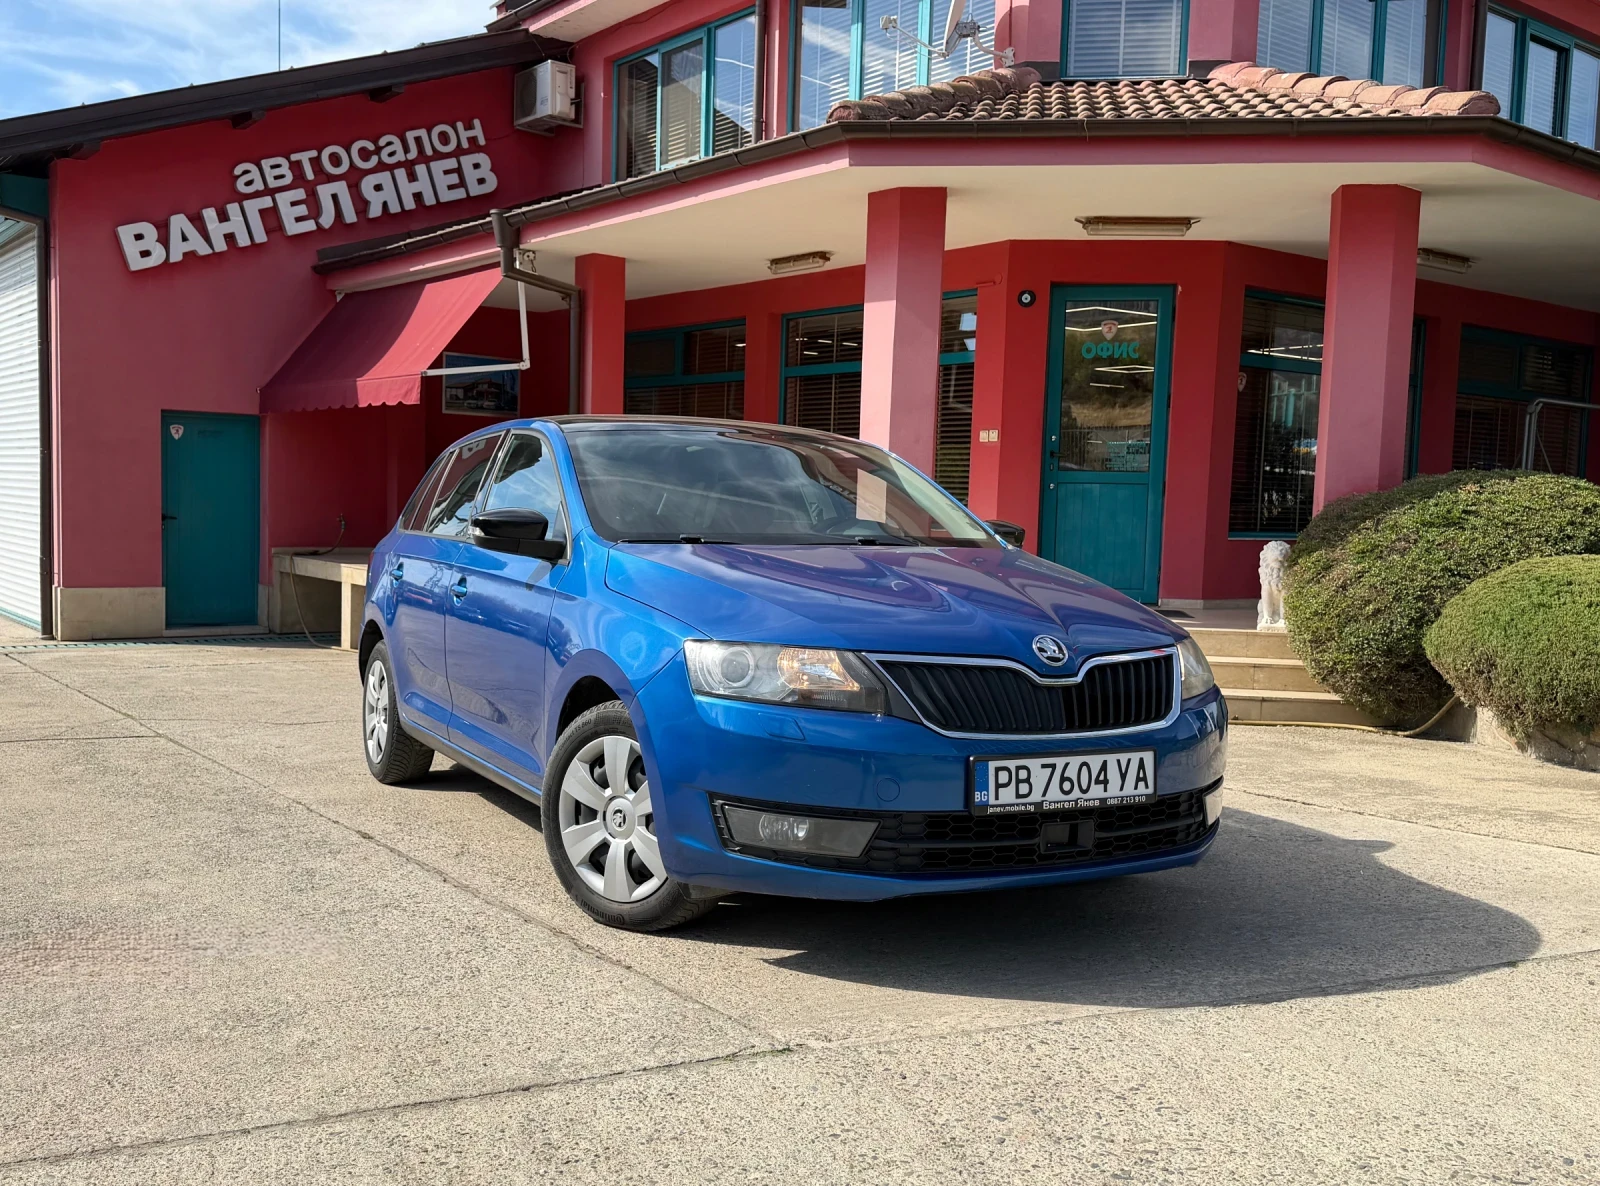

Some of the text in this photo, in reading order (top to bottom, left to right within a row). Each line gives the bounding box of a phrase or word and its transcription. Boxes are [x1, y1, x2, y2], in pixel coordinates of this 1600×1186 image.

[233, 118, 486, 194] автосалон
[115, 152, 498, 272] ВАНГЕЛ ЯНЕВ
[1081, 341, 1140, 360] ОФИС
[1041, 759, 1110, 798] 7604
[974, 791, 988, 802] BG
[1043, 798, 1100, 810] Вангел Янев
[1122, 796, 1134, 804] 213
[1134, 795, 1146, 803] 910
